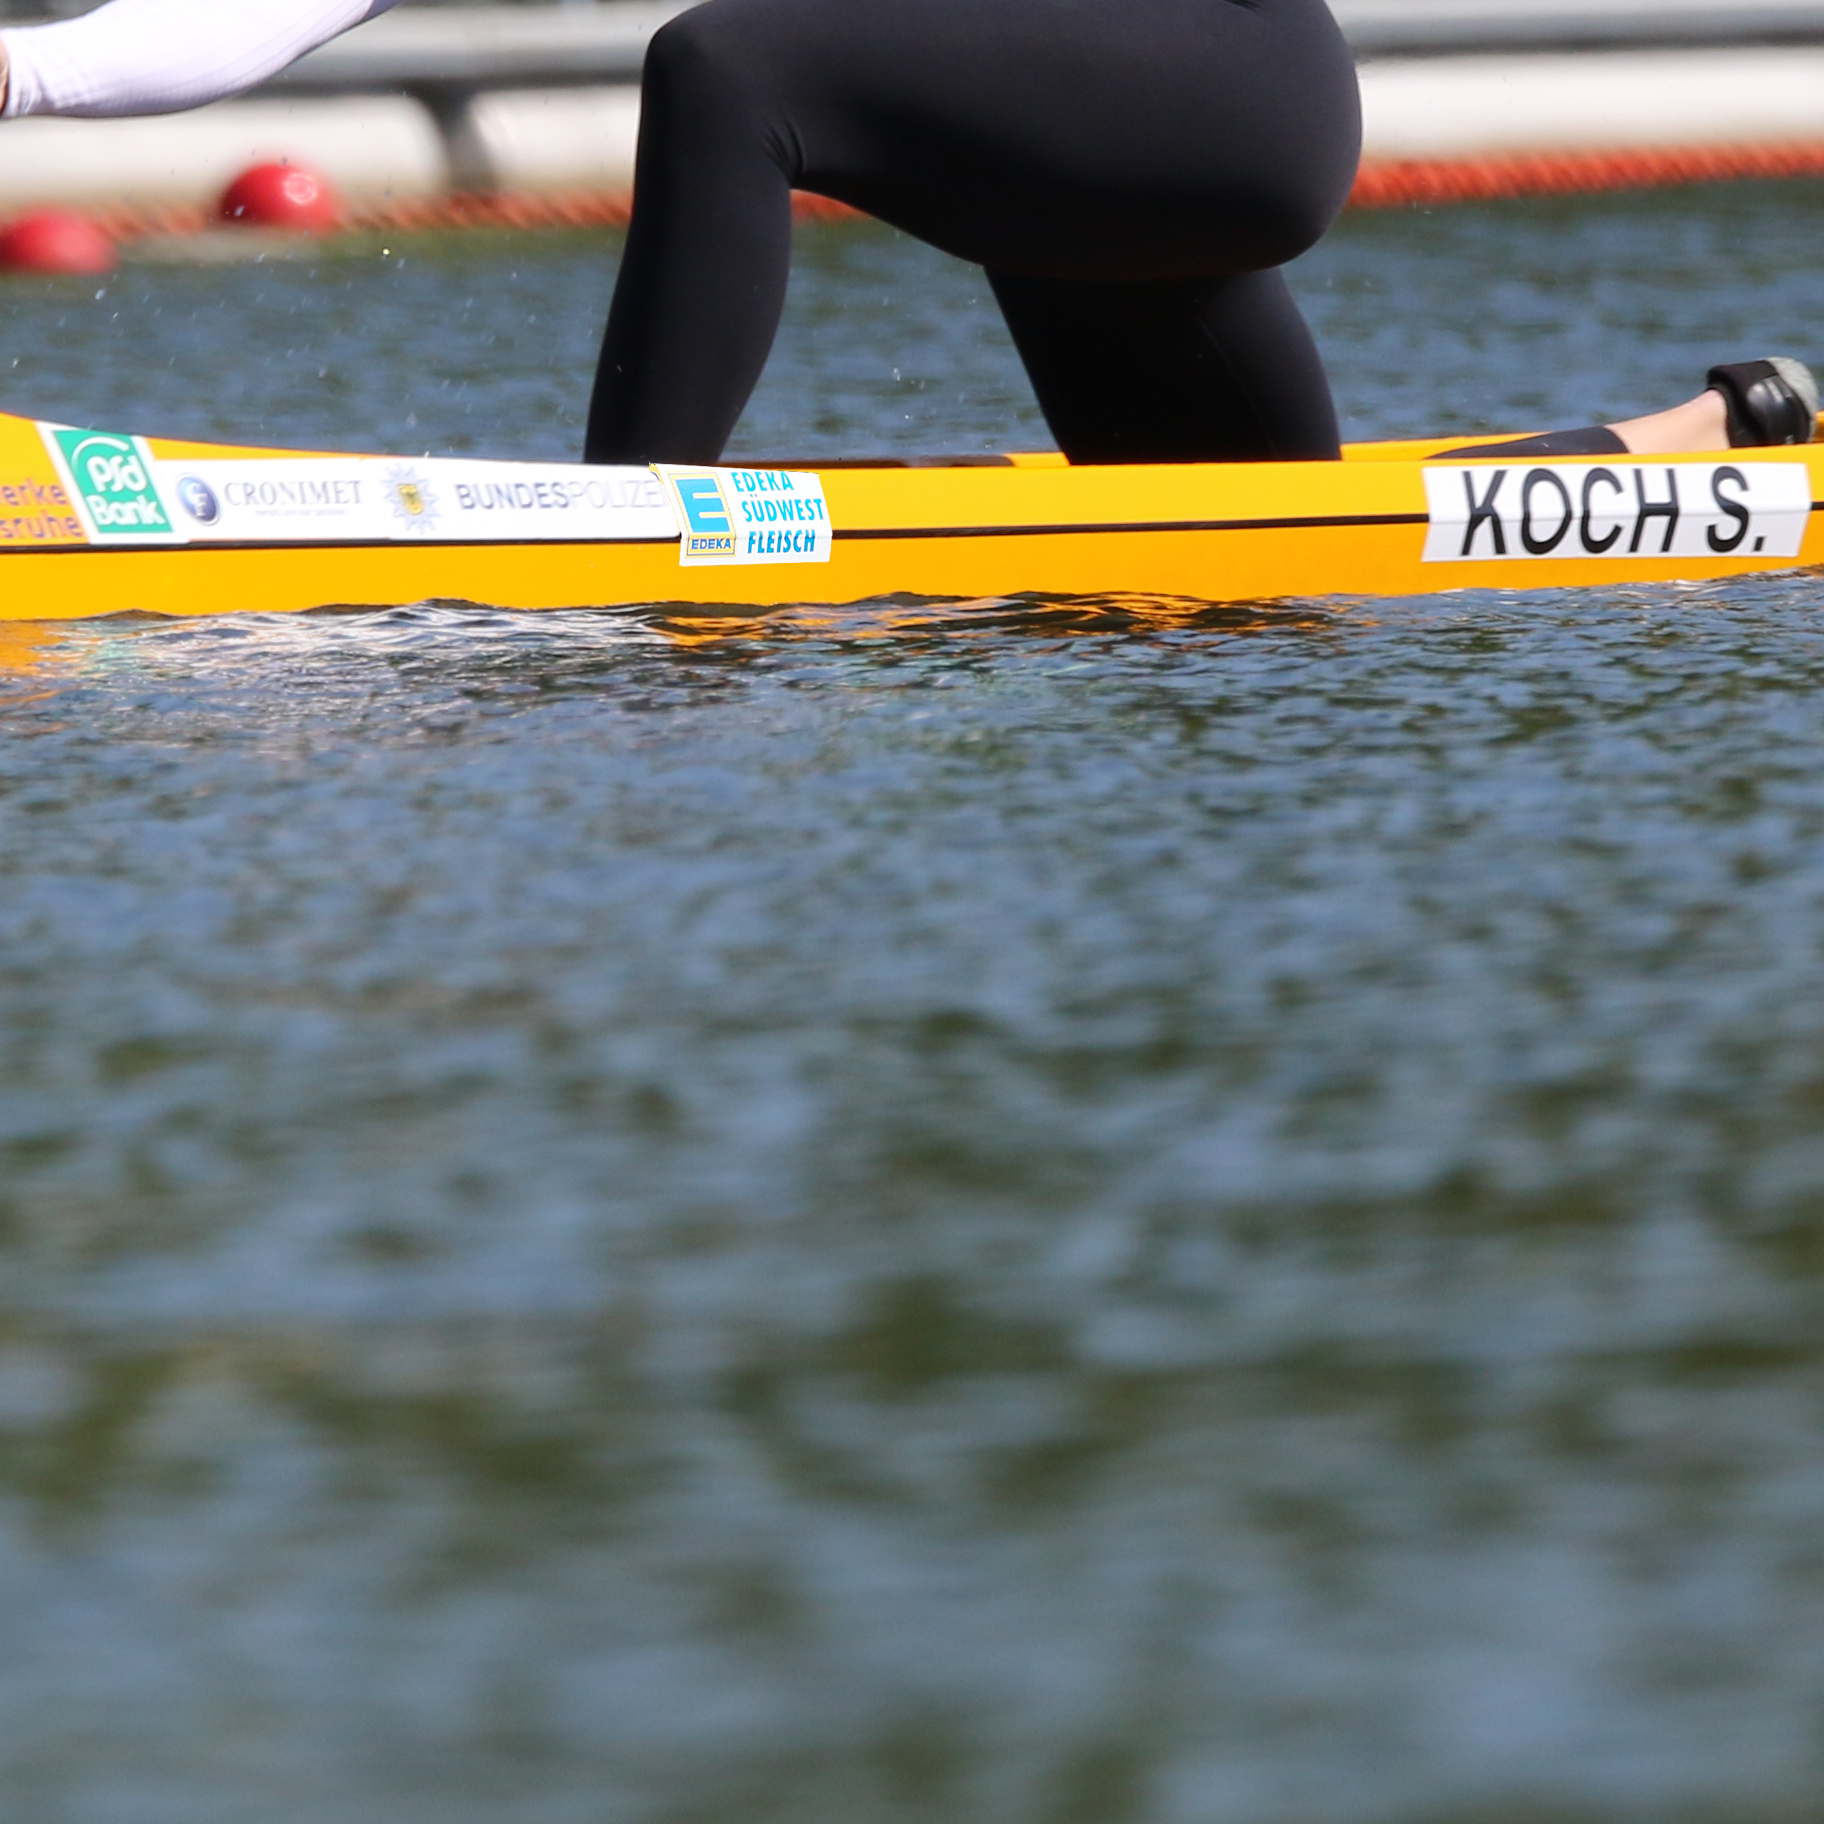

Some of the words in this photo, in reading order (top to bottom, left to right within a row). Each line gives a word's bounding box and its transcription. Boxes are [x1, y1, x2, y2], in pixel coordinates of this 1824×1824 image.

[223, 479, 364, 507] CRONIMET
[730, 470, 795, 493] EDEKA
[85, 494, 167, 526] Bank
[741, 493, 824, 523] SÜDWEST
[1460, 466, 1679, 556] KOCH
[1706, 464, 1767, 554] S.
[690, 537, 732, 551] EDEKA
[747, 528, 816, 555] FLEISCH
